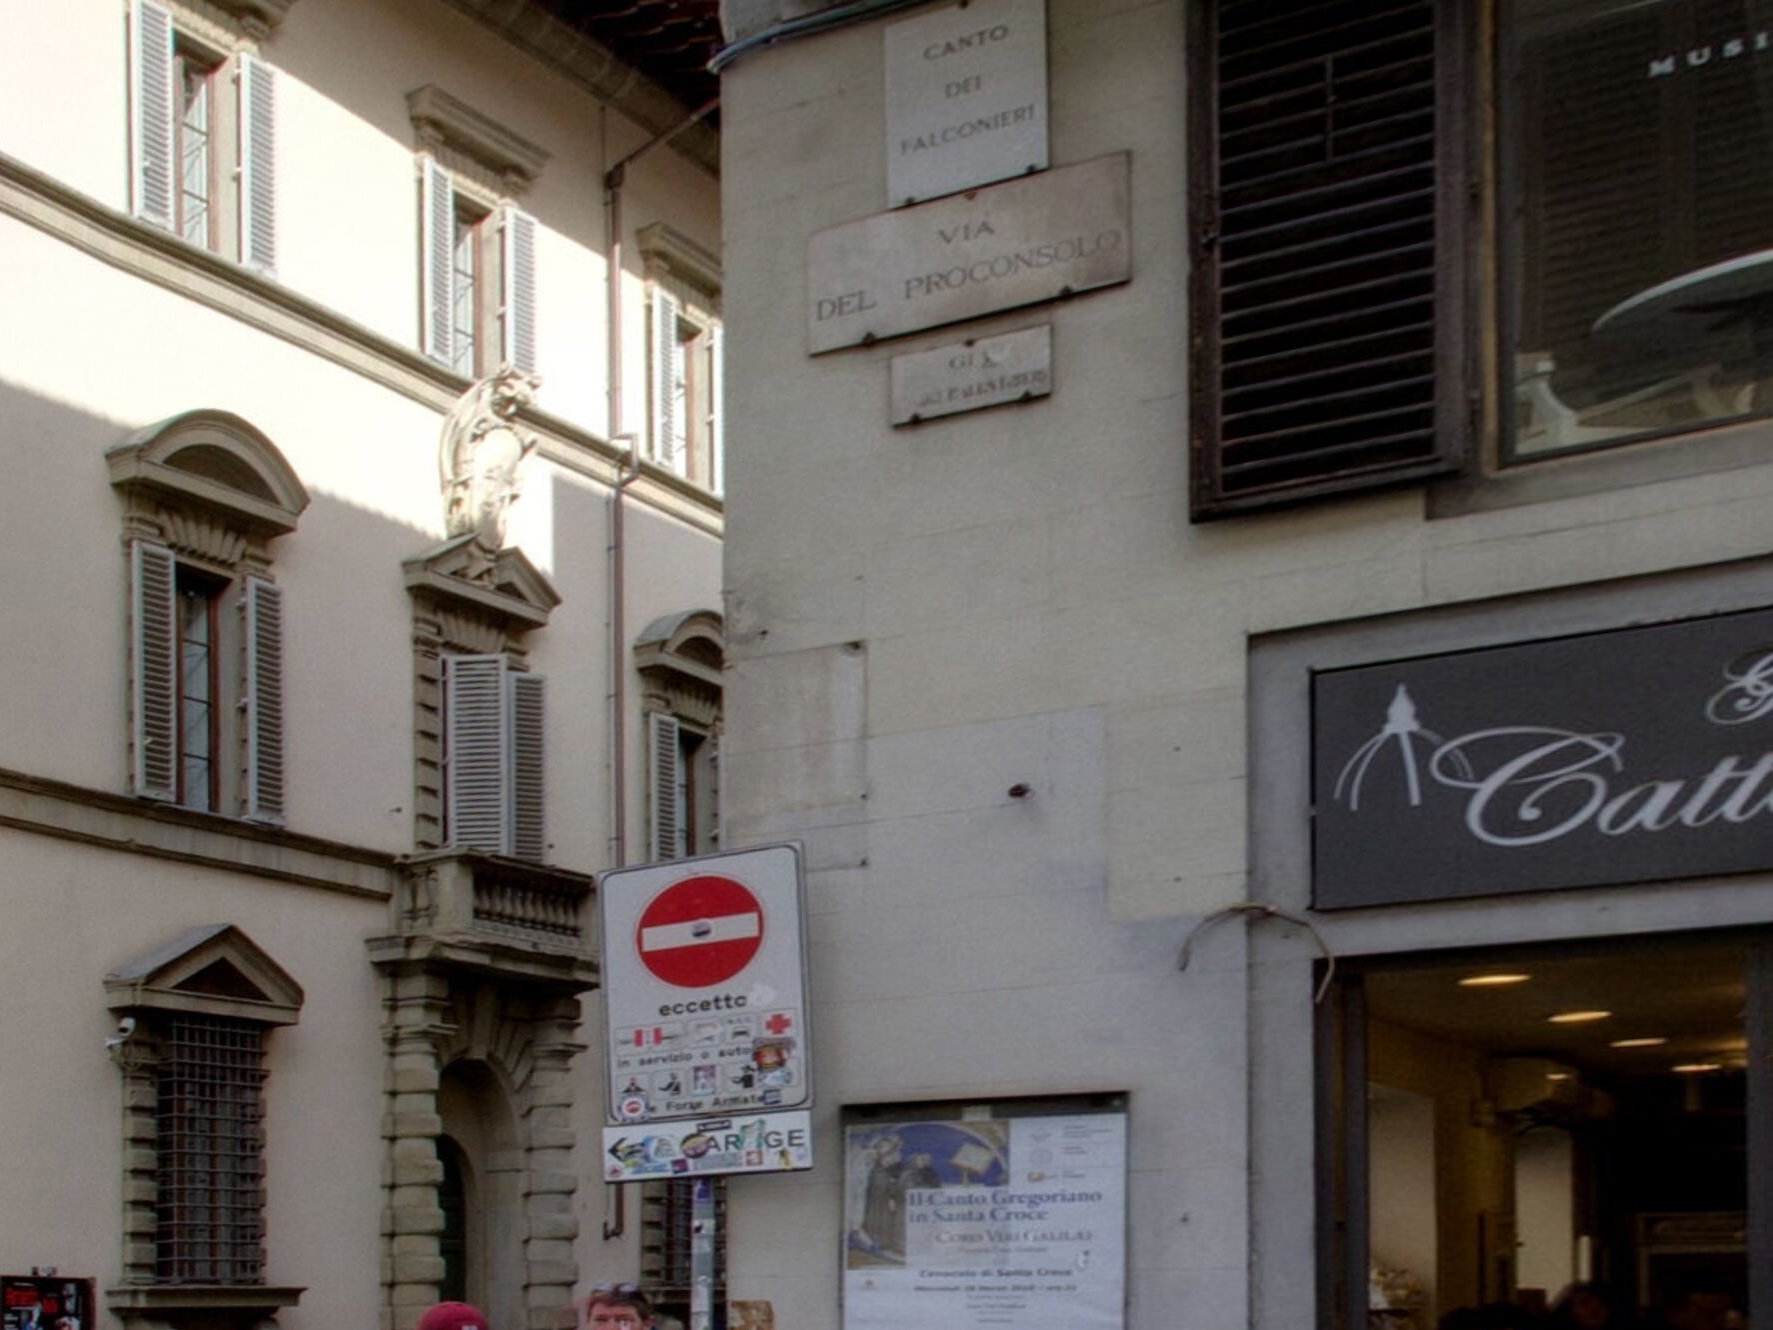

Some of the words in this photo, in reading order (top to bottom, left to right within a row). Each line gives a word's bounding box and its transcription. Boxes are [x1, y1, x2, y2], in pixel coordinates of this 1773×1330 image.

[922, 24, 1009, 60] CANTO
[944, 75, 982, 99] DEI
[899, 103, 1035, 156] FALCONIERI
[938, 219, 995, 245] VIA
[815, 289, 878, 321] DEL
[903, 228, 1122, 300] PROCONSOLO
[659, 994, 748, 1016] eccetto
[926, 1191, 987, 1206] Canto
[991, 1190, 1103, 1208] Gregoriano
[909, 1212, 928, 1223] in
[932, 1208, 985, 1222] Santa
[990, 1207, 1049, 1222] Croce
